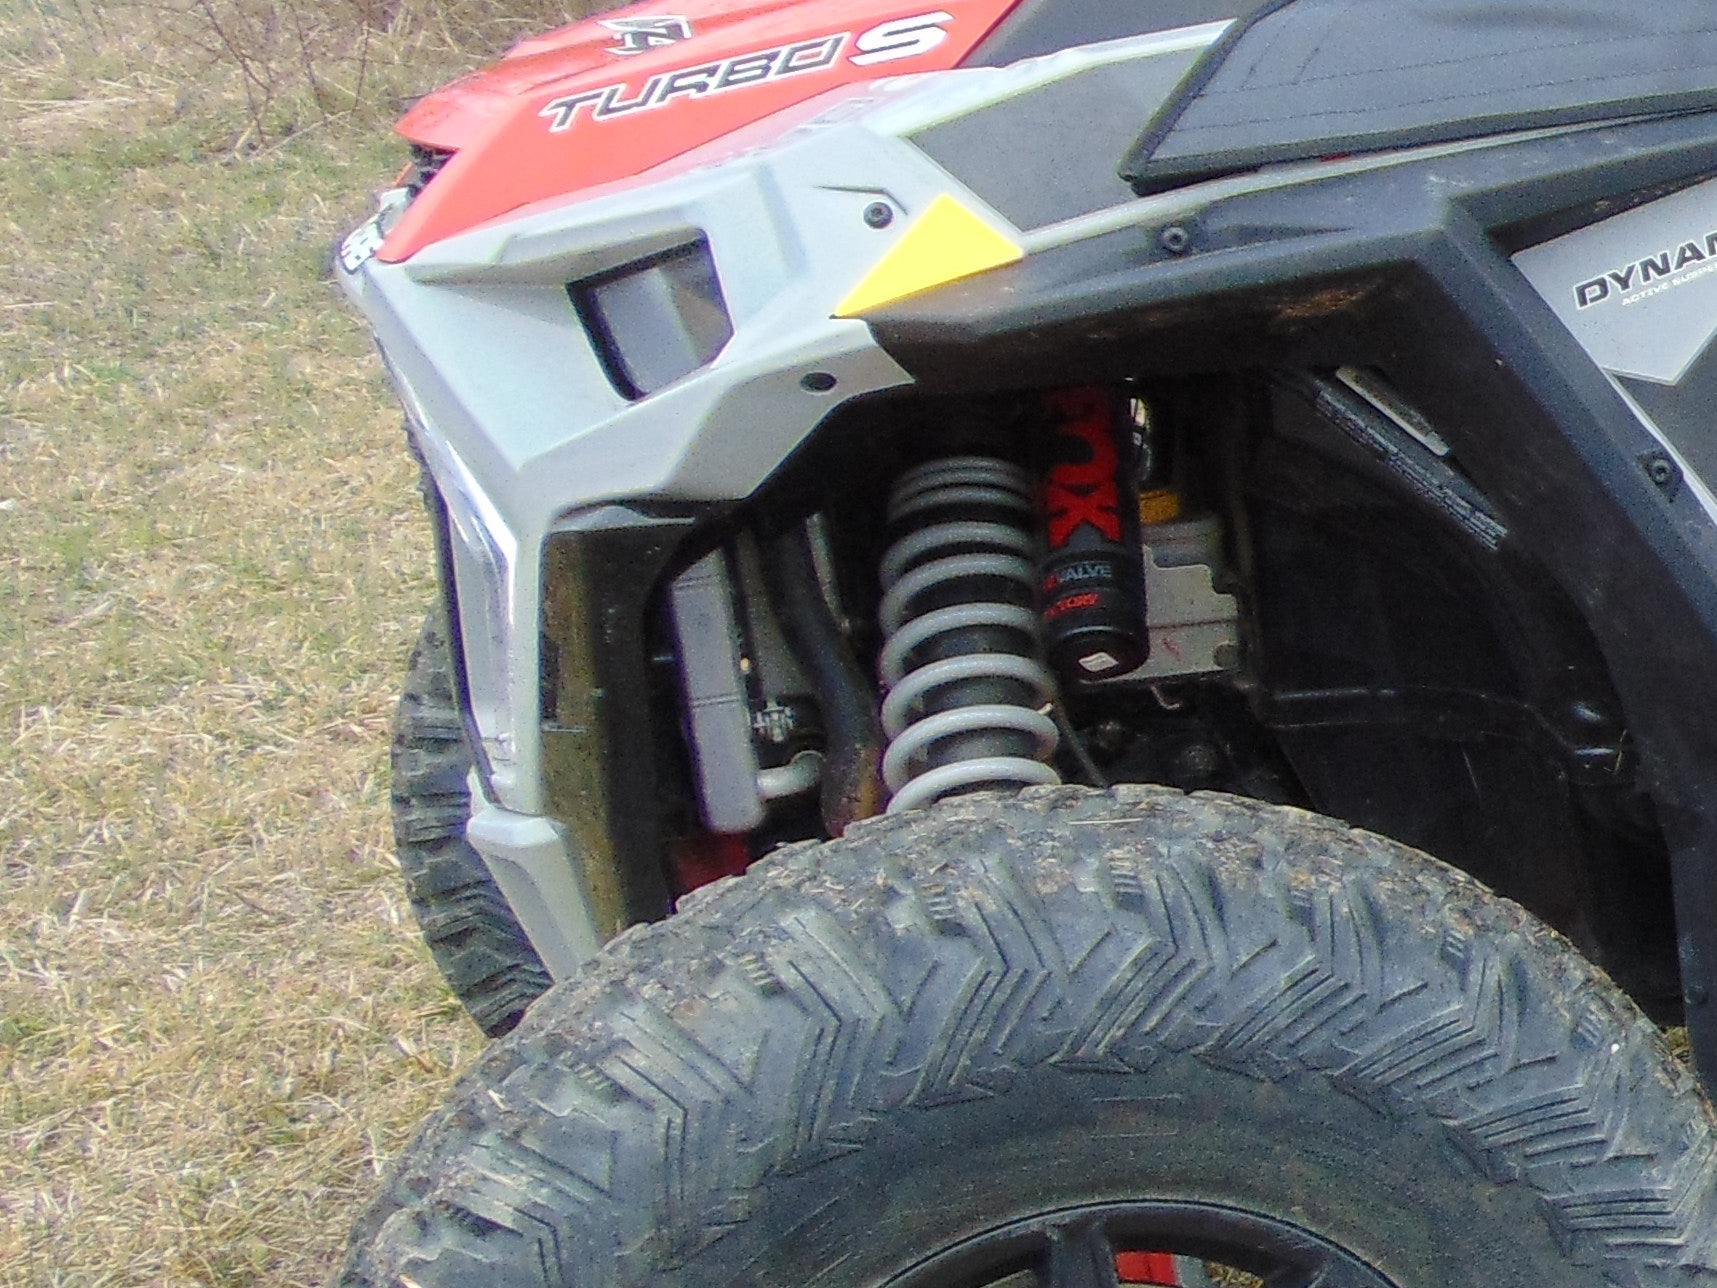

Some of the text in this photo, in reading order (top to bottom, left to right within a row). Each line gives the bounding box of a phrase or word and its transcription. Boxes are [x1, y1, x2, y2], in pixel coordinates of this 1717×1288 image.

[539, 10, 957, 133] TURBO S
[1622, 282, 1669, 306] ACTIVE
